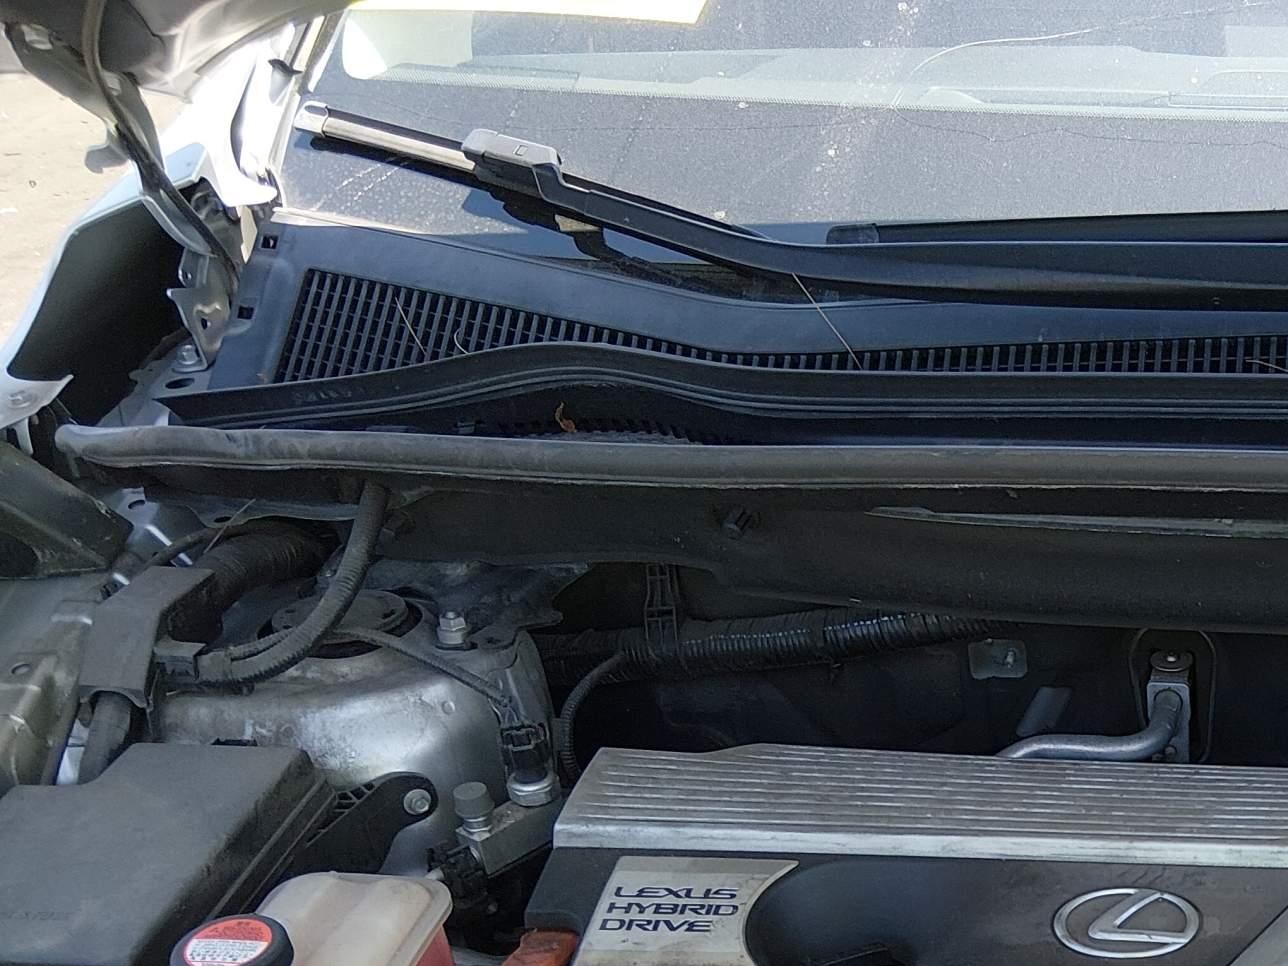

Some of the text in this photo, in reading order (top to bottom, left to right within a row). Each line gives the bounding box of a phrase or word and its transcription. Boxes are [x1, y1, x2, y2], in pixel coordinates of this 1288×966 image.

[614, 886, 739, 899] LEXUS
[606, 902, 740, 916] HYBRID
[599, 918, 713, 932] DRIVE
